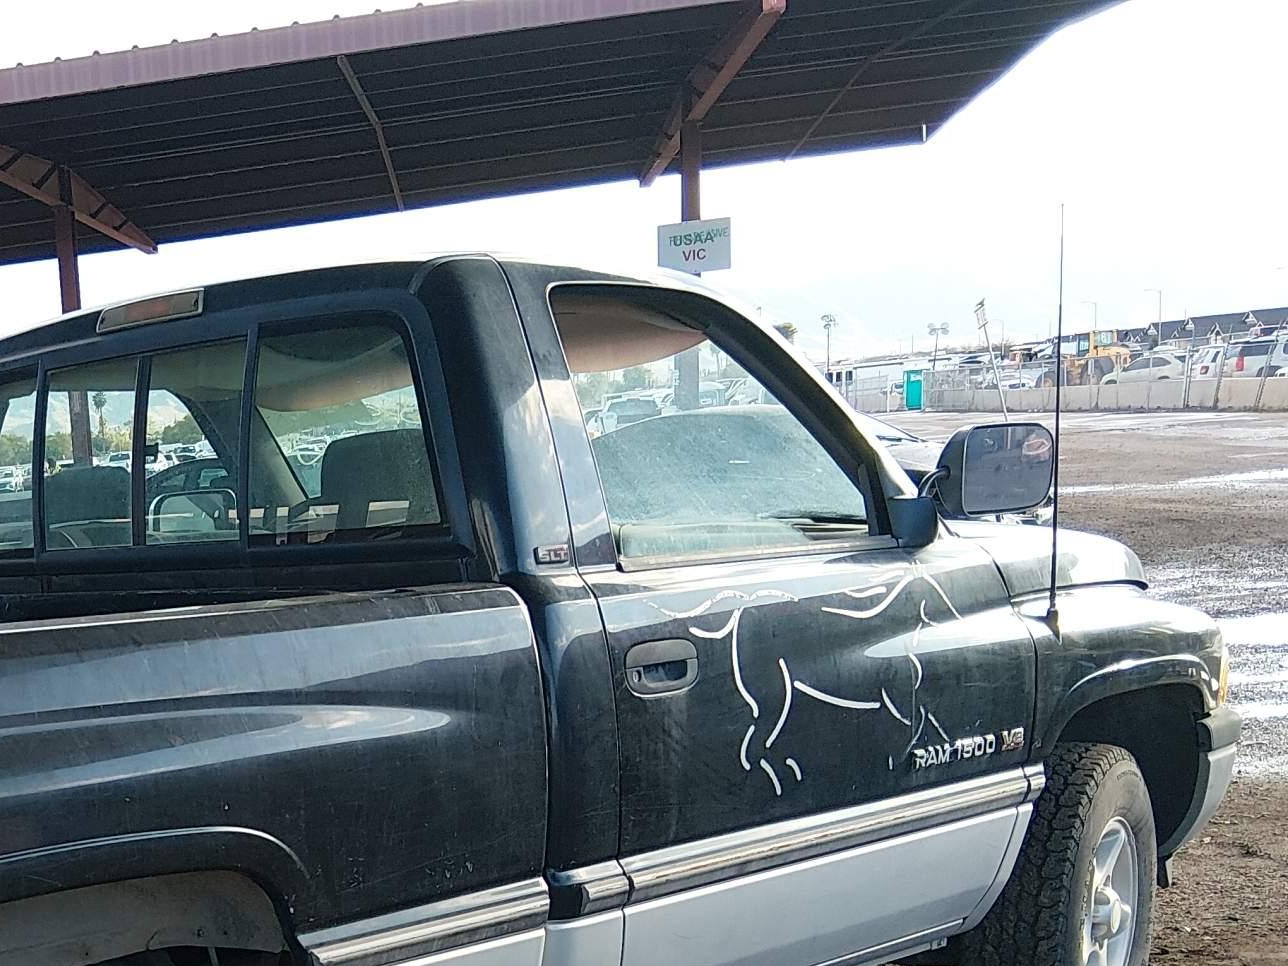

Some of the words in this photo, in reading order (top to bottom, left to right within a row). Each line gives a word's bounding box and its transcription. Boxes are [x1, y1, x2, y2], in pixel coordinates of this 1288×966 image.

[673, 231, 715, 247] USAA
[682, 248, 706, 262] VIC
[539, 550, 569, 561] SLT
[912, 743, 950, 769] RAM
[951, 734, 996, 760] 1500
